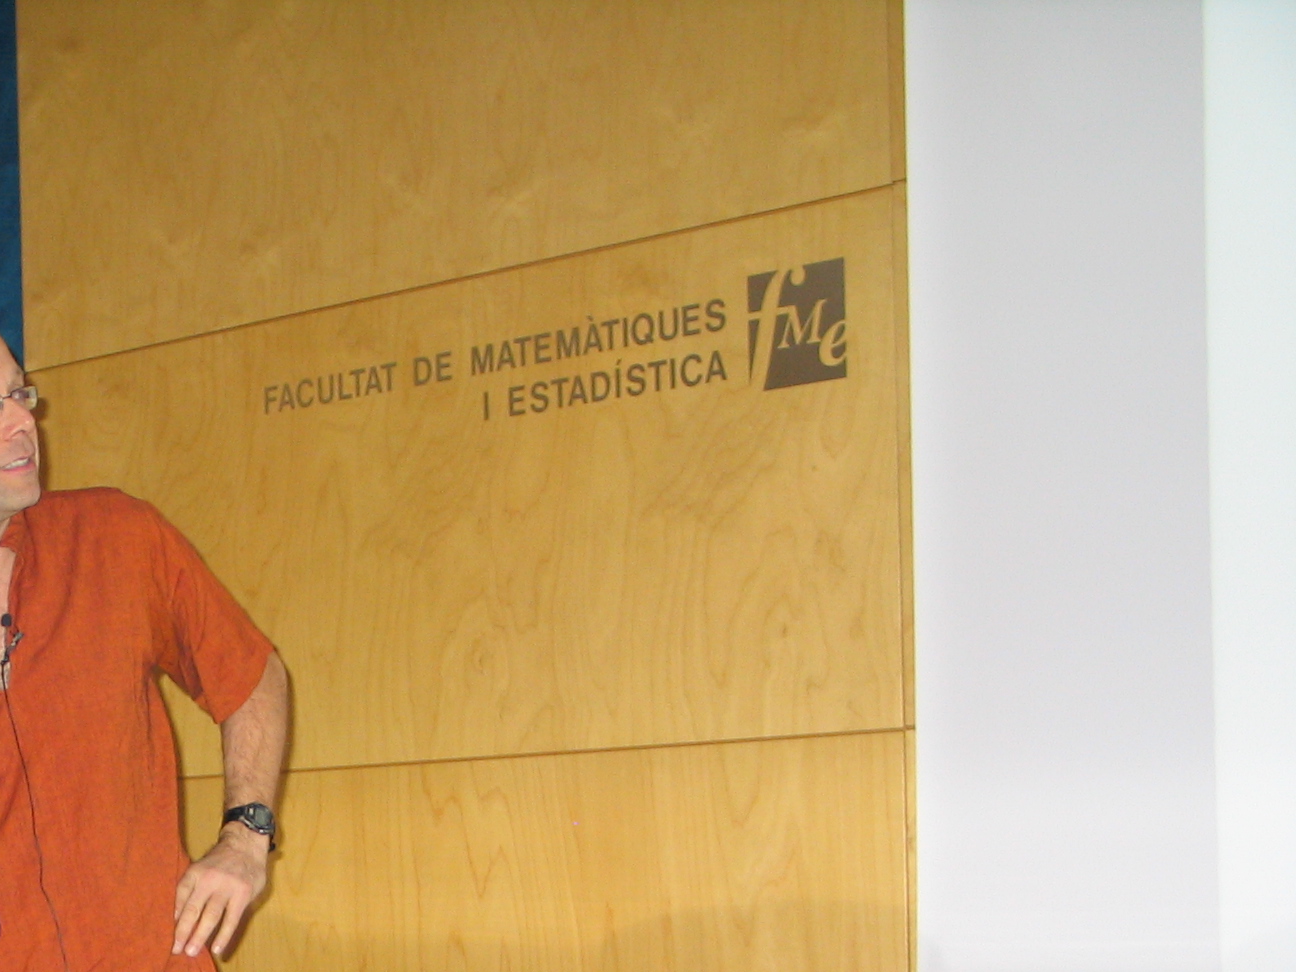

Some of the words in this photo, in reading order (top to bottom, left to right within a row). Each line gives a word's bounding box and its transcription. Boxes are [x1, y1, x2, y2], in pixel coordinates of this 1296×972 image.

[264, 363, 396, 414] FACULTAT
[413, 351, 452, 387] DE
[471, 299, 726, 376] MATEMÀTIQUES
[482, 390, 490, 421] I
[508, 350, 727, 417] ESTADÍSTICA
